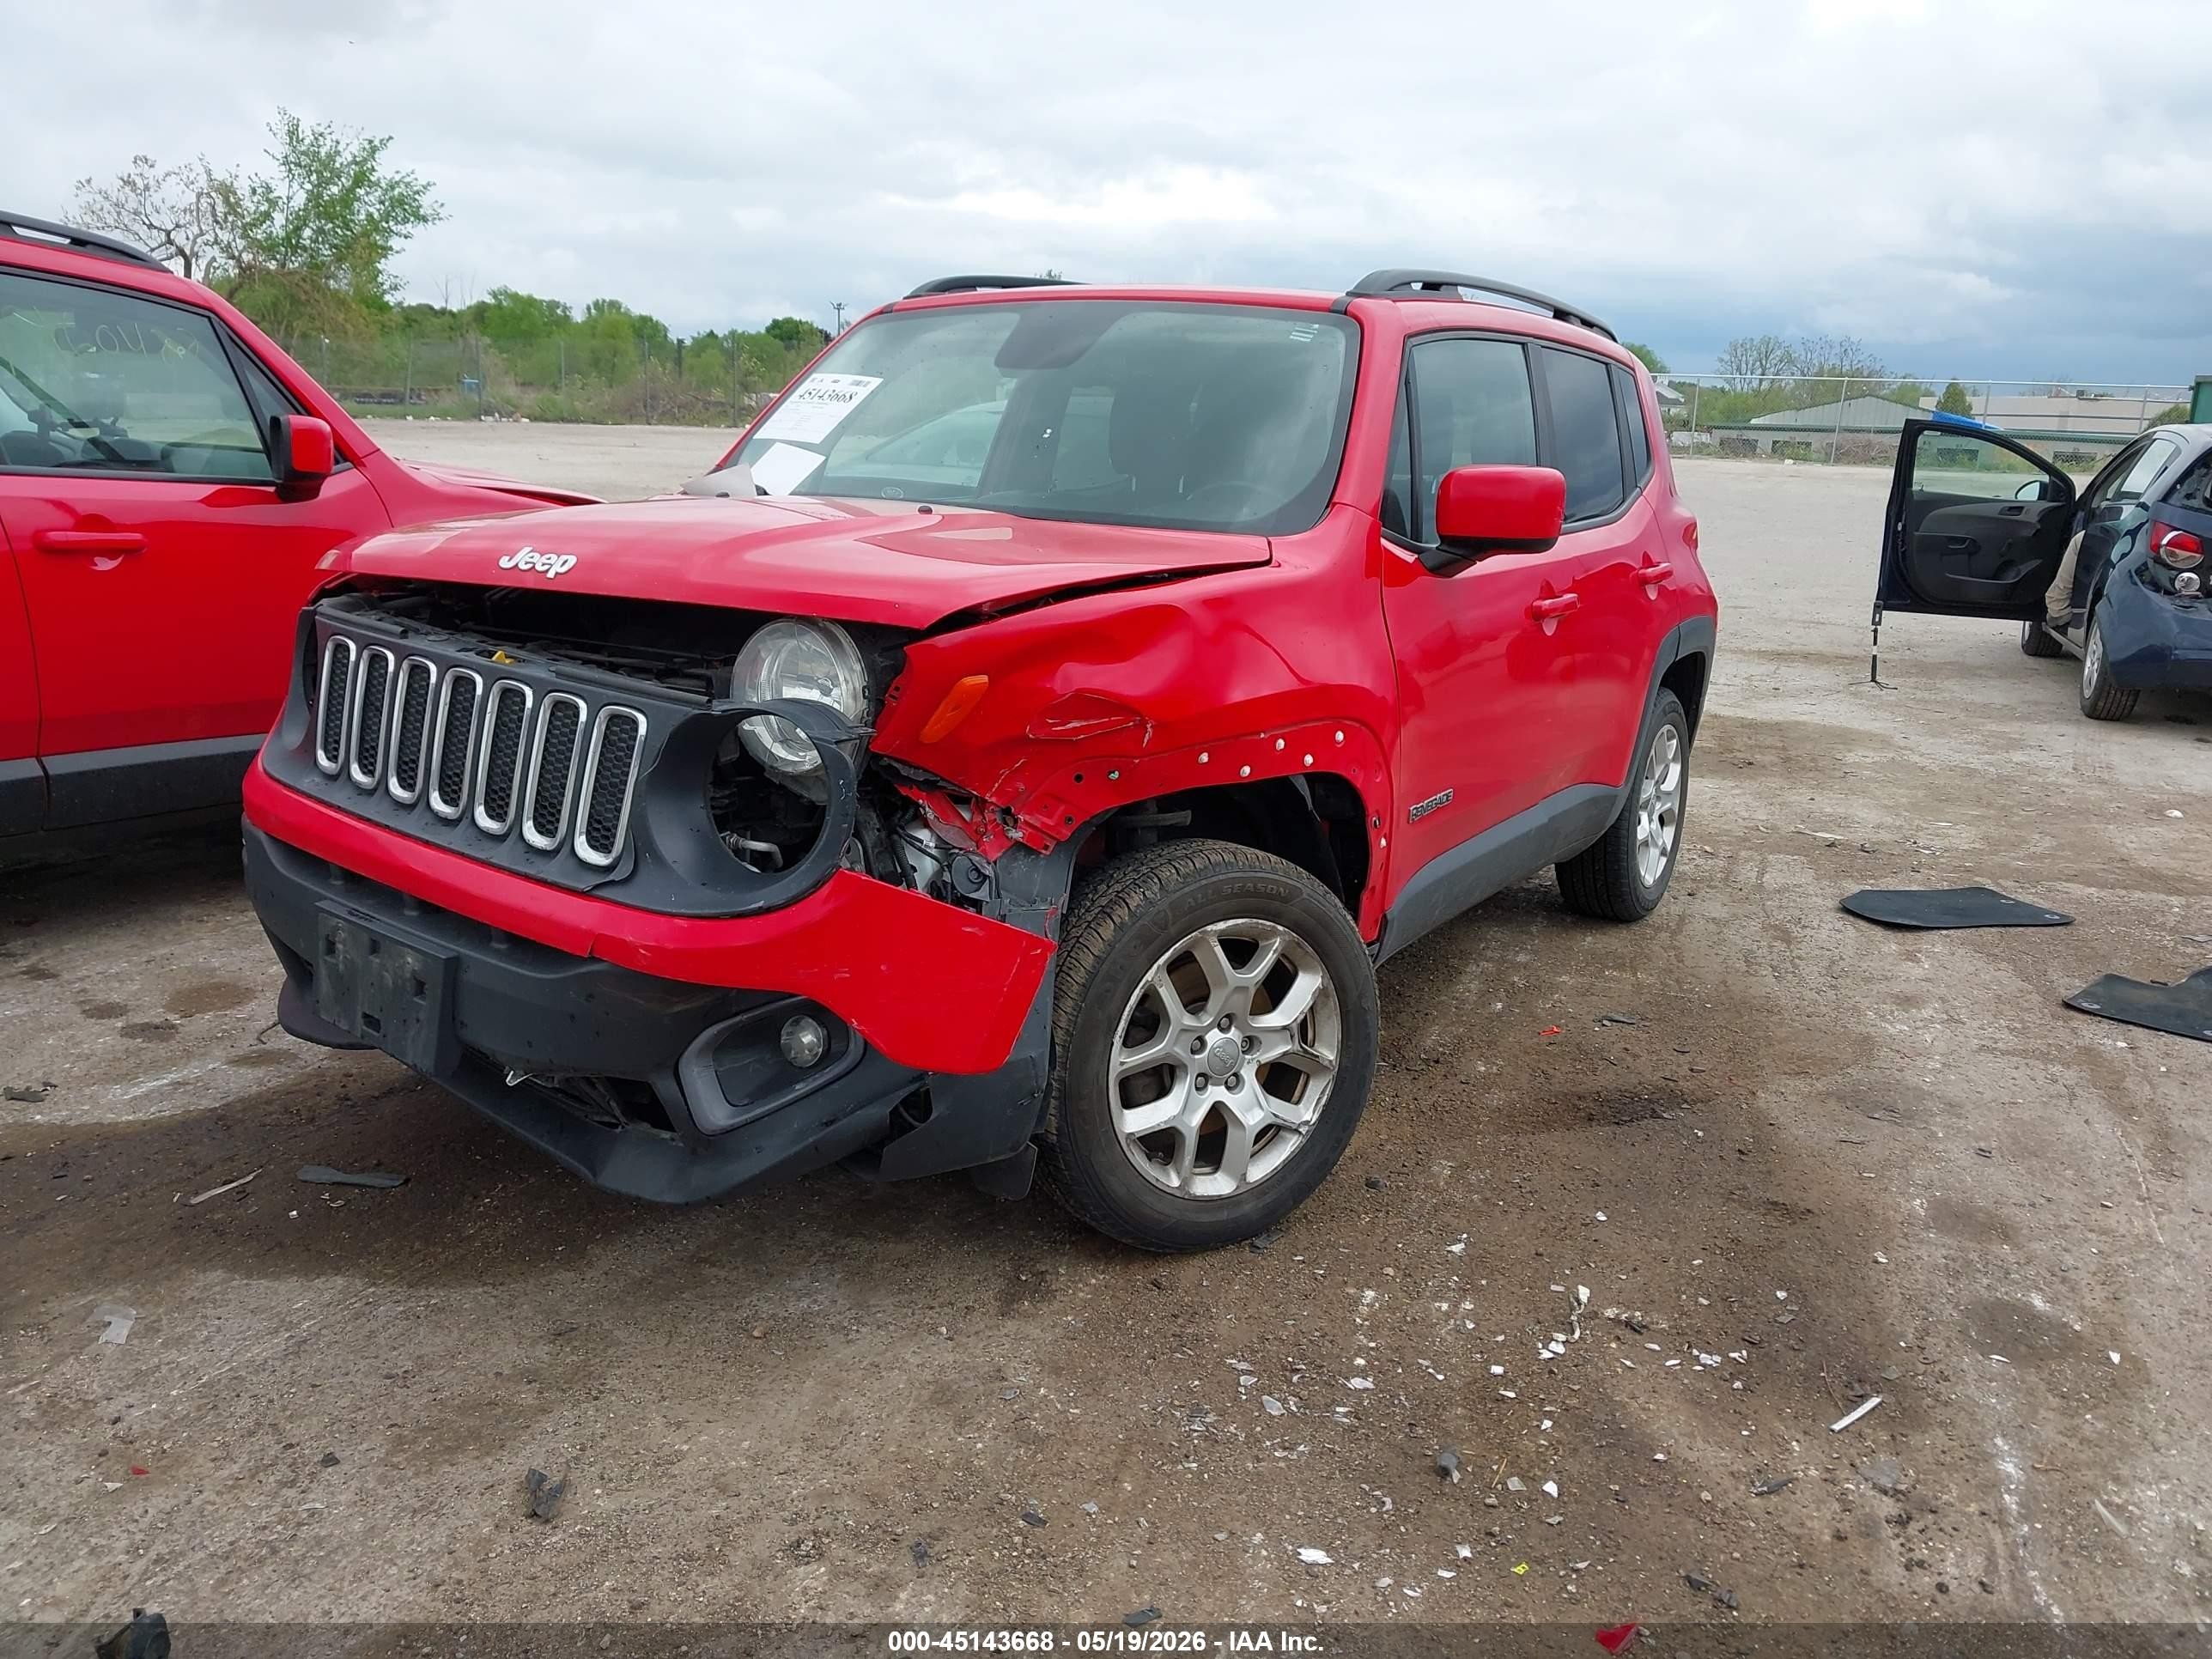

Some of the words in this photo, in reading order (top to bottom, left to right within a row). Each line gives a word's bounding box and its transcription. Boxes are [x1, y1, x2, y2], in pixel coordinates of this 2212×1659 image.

[498, 546, 578, 579] Jeep
[1186, 890, 1217, 907] ALL
[1221, 883, 1289, 897] SEASON
